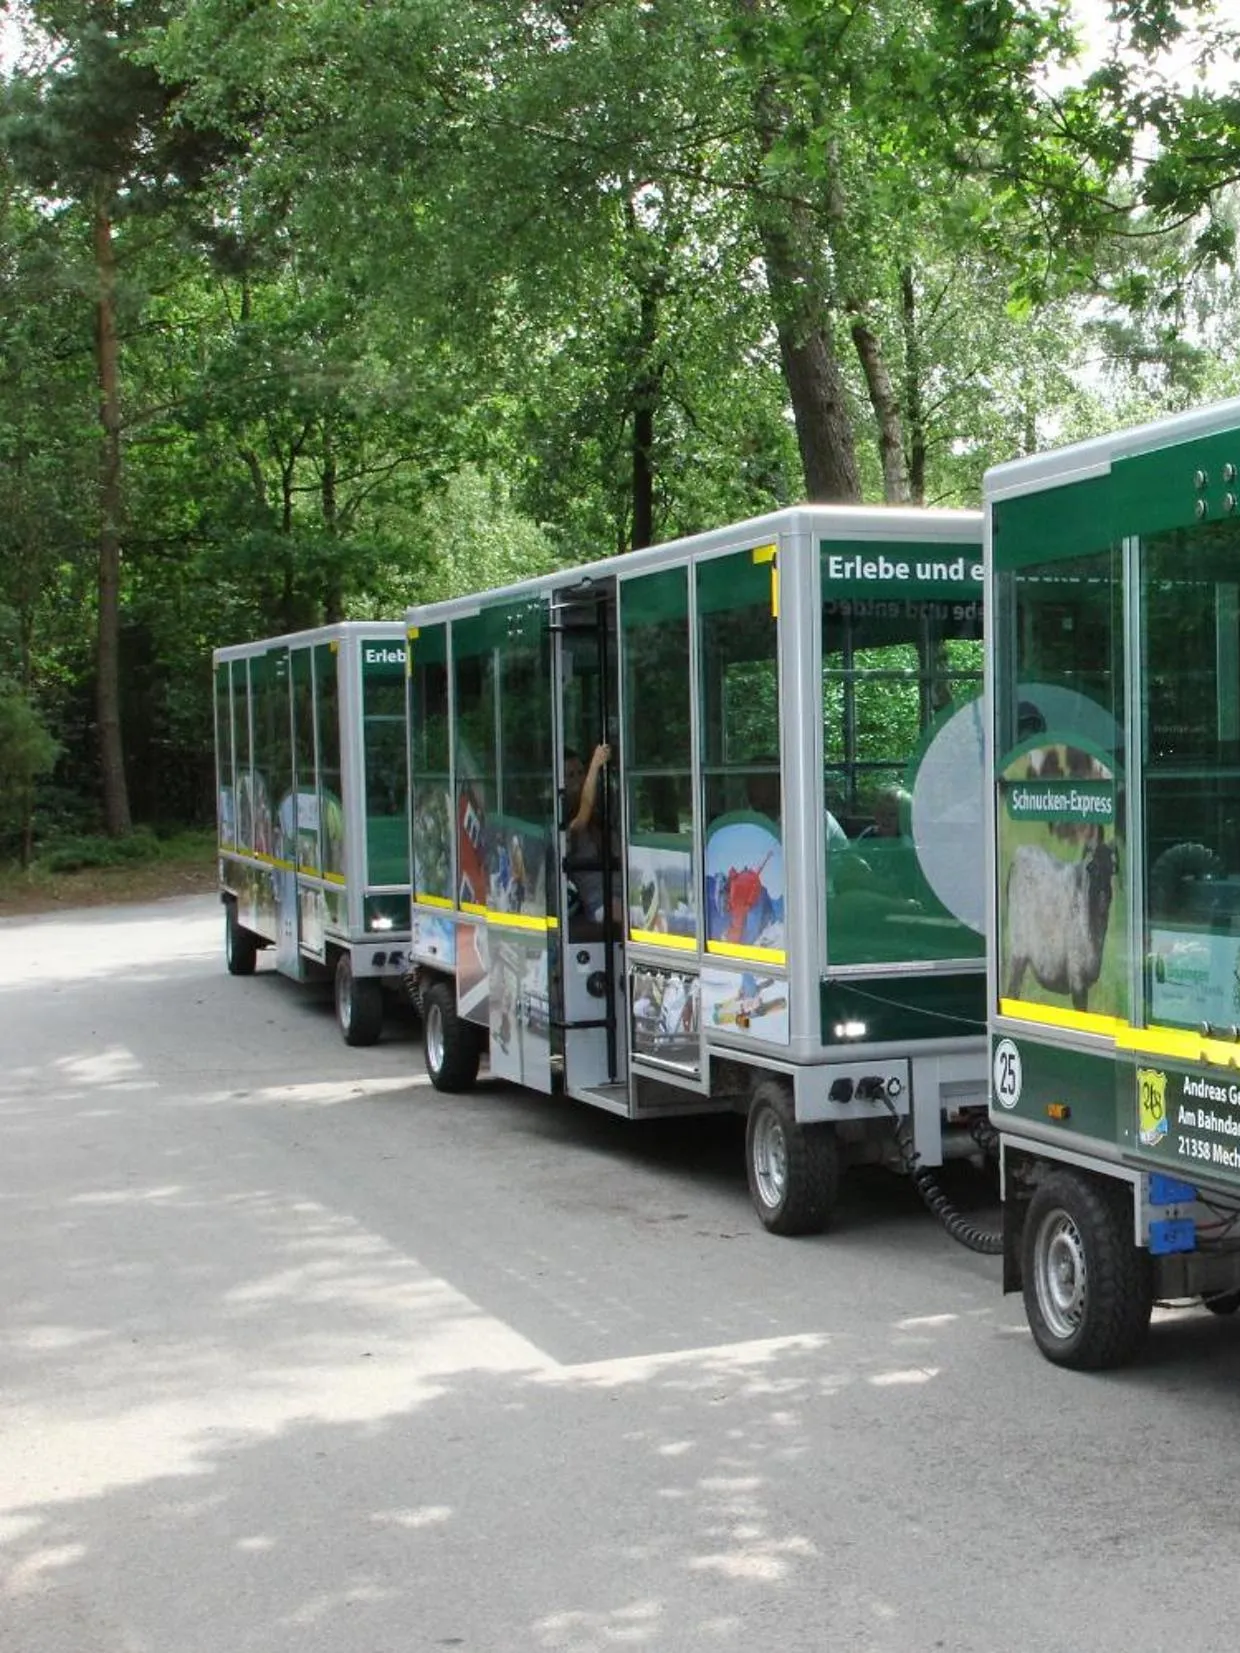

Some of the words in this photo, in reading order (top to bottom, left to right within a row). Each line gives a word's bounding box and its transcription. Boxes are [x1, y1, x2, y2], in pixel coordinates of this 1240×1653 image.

[829, 555, 909, 580] Erlebe
[916, 557, 964, 580] und
[1013, 788, 1112, 818] Schnucken-Express
[1000, 1052, 1016, 1096] 25
[1183, 1076, 1227, 1103] Andreas
[1178, 1105, 1196, 1126] Am
[1178, 1136, 1211, 1161] 21358
